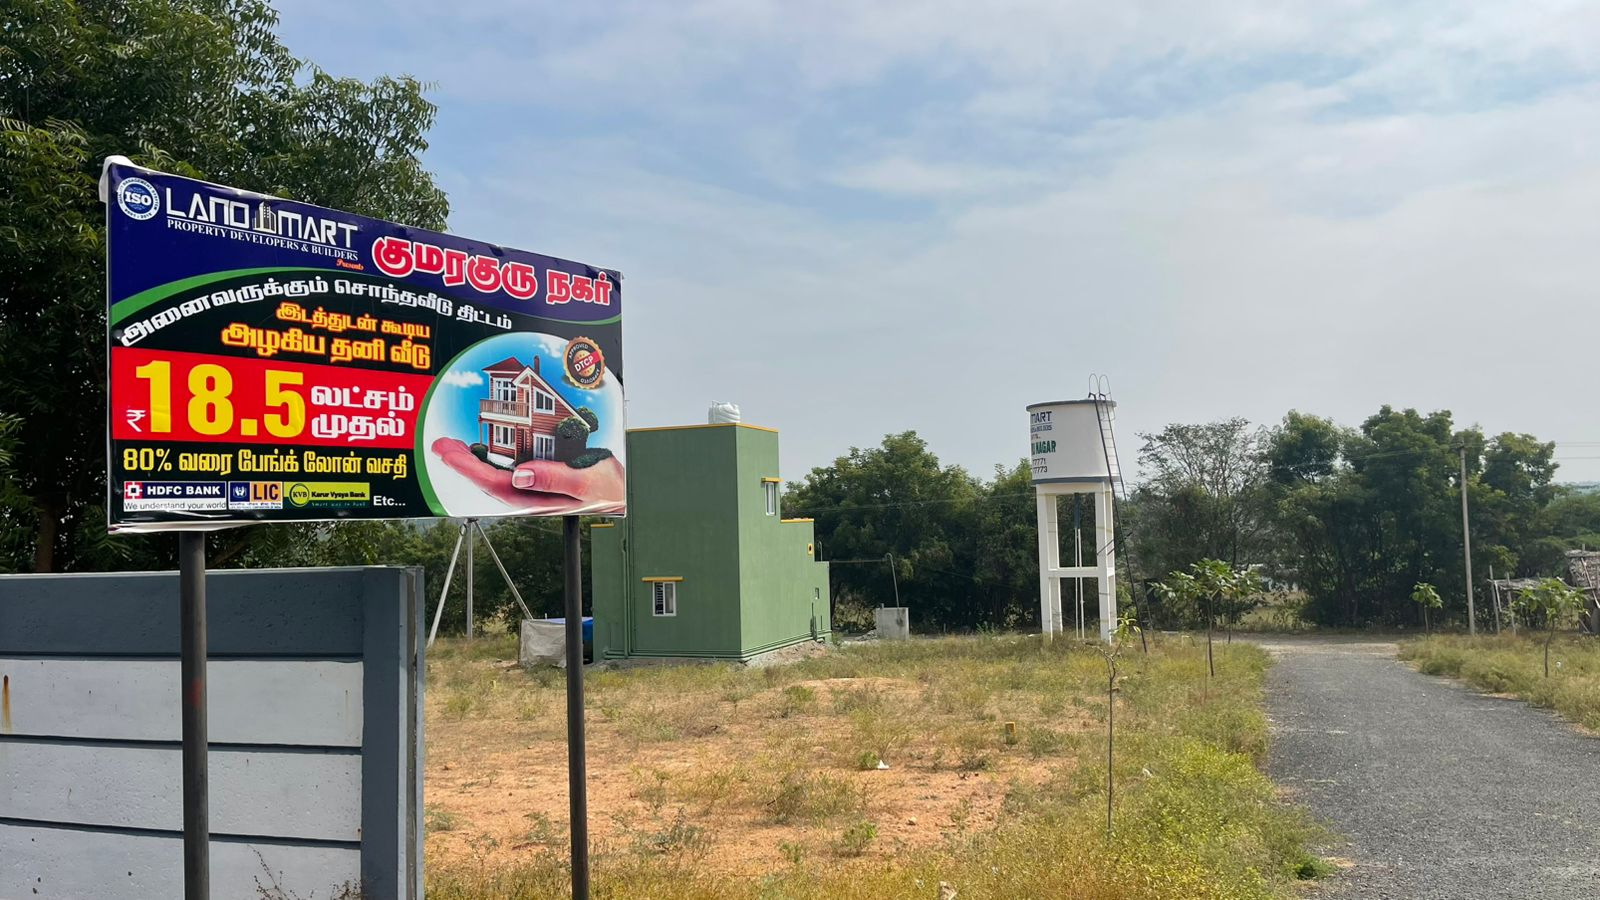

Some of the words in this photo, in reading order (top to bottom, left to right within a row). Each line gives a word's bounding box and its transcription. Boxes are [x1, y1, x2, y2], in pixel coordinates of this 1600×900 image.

[125, 191, 152, 205] ISO
[167, 219, 228, 237] PROPERTY
[230, 230, 299, 250] DEVELOPERS
[301, 244, 309, 252] &
[312, 246, 358, 261] BUILDERS
[278, 210, 358, 248] MART
[372, 236, 538, 300] குமரகுரு
[546, 270, 612, 306] நகர்
[121, 276, 329, 347] அனைவருக்கும்
[456, 305, 512, 330] திட்டம்
[276, 301, 378, 332] இடத்துடன்
[381, 319, 430, 339] கூடிய
[221, 322, 326, 356] அழகிய
[330, 337, 385, 363] தனி
[390, 340, 431, 370] வீடு
[574, 355, 594, 372] DTCP
[311, 385, 415, 411] லட்சம்
[311, 411, 406, 442] முதல்
[1036, 440, 1056, 454] NAGAR
[123, 448, 172, 472] 80%
[179, 453, 233, 476] வரை
[238, 448, 299, 472] பேங்க்
[303, 450, 362, 473] லோன்
[366, 454, 407, 480] வசதி
[124, 502, 138, 510] We
[140, 500, 185, 510] understand
[187, 502, 207, 511] your
[208, 500, 226, 509] world
[147, 486, 182, 495] HDFC
[186, 486, 221, 495] BANK
[253, 484, 279, 500] LIC
